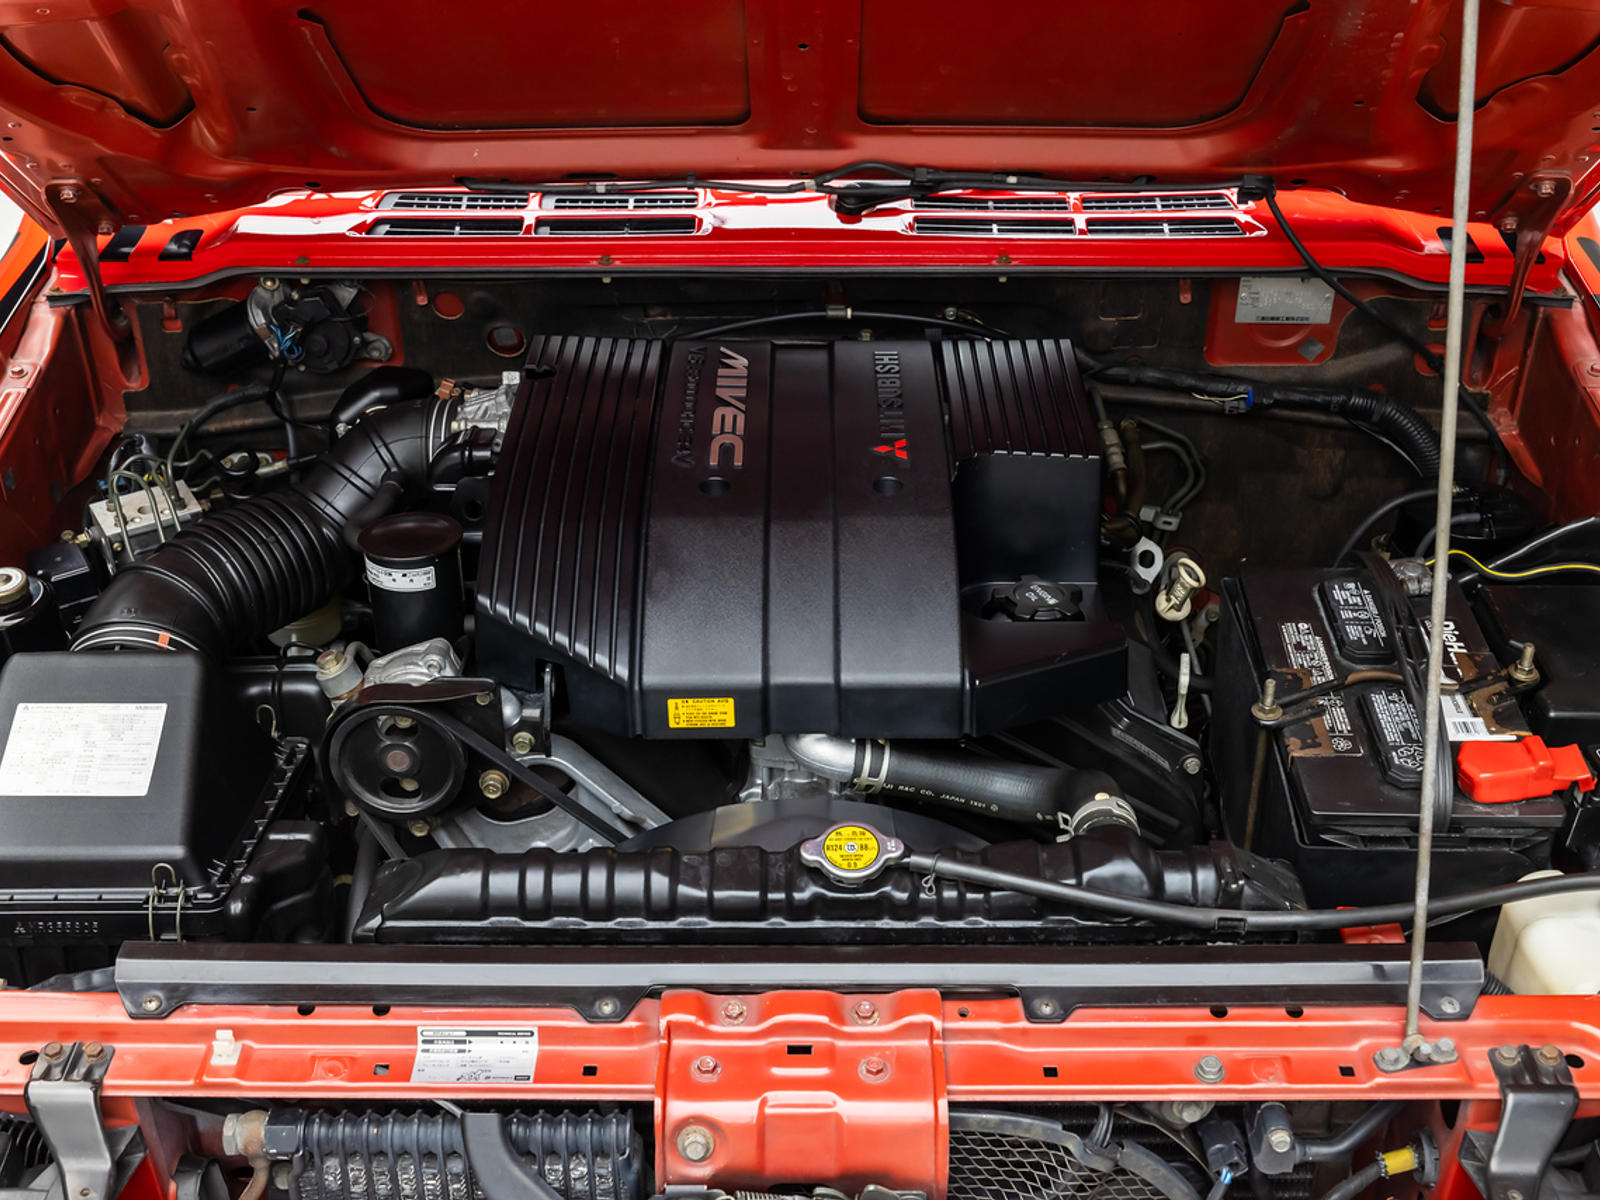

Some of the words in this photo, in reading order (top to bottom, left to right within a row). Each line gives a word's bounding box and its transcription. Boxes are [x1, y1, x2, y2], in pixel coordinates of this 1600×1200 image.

[709, 346, 749, 467] MIVEC
[874, 351, 906, 438] MITSUBISHI
[940, 793, 965, 803] JAPAN
